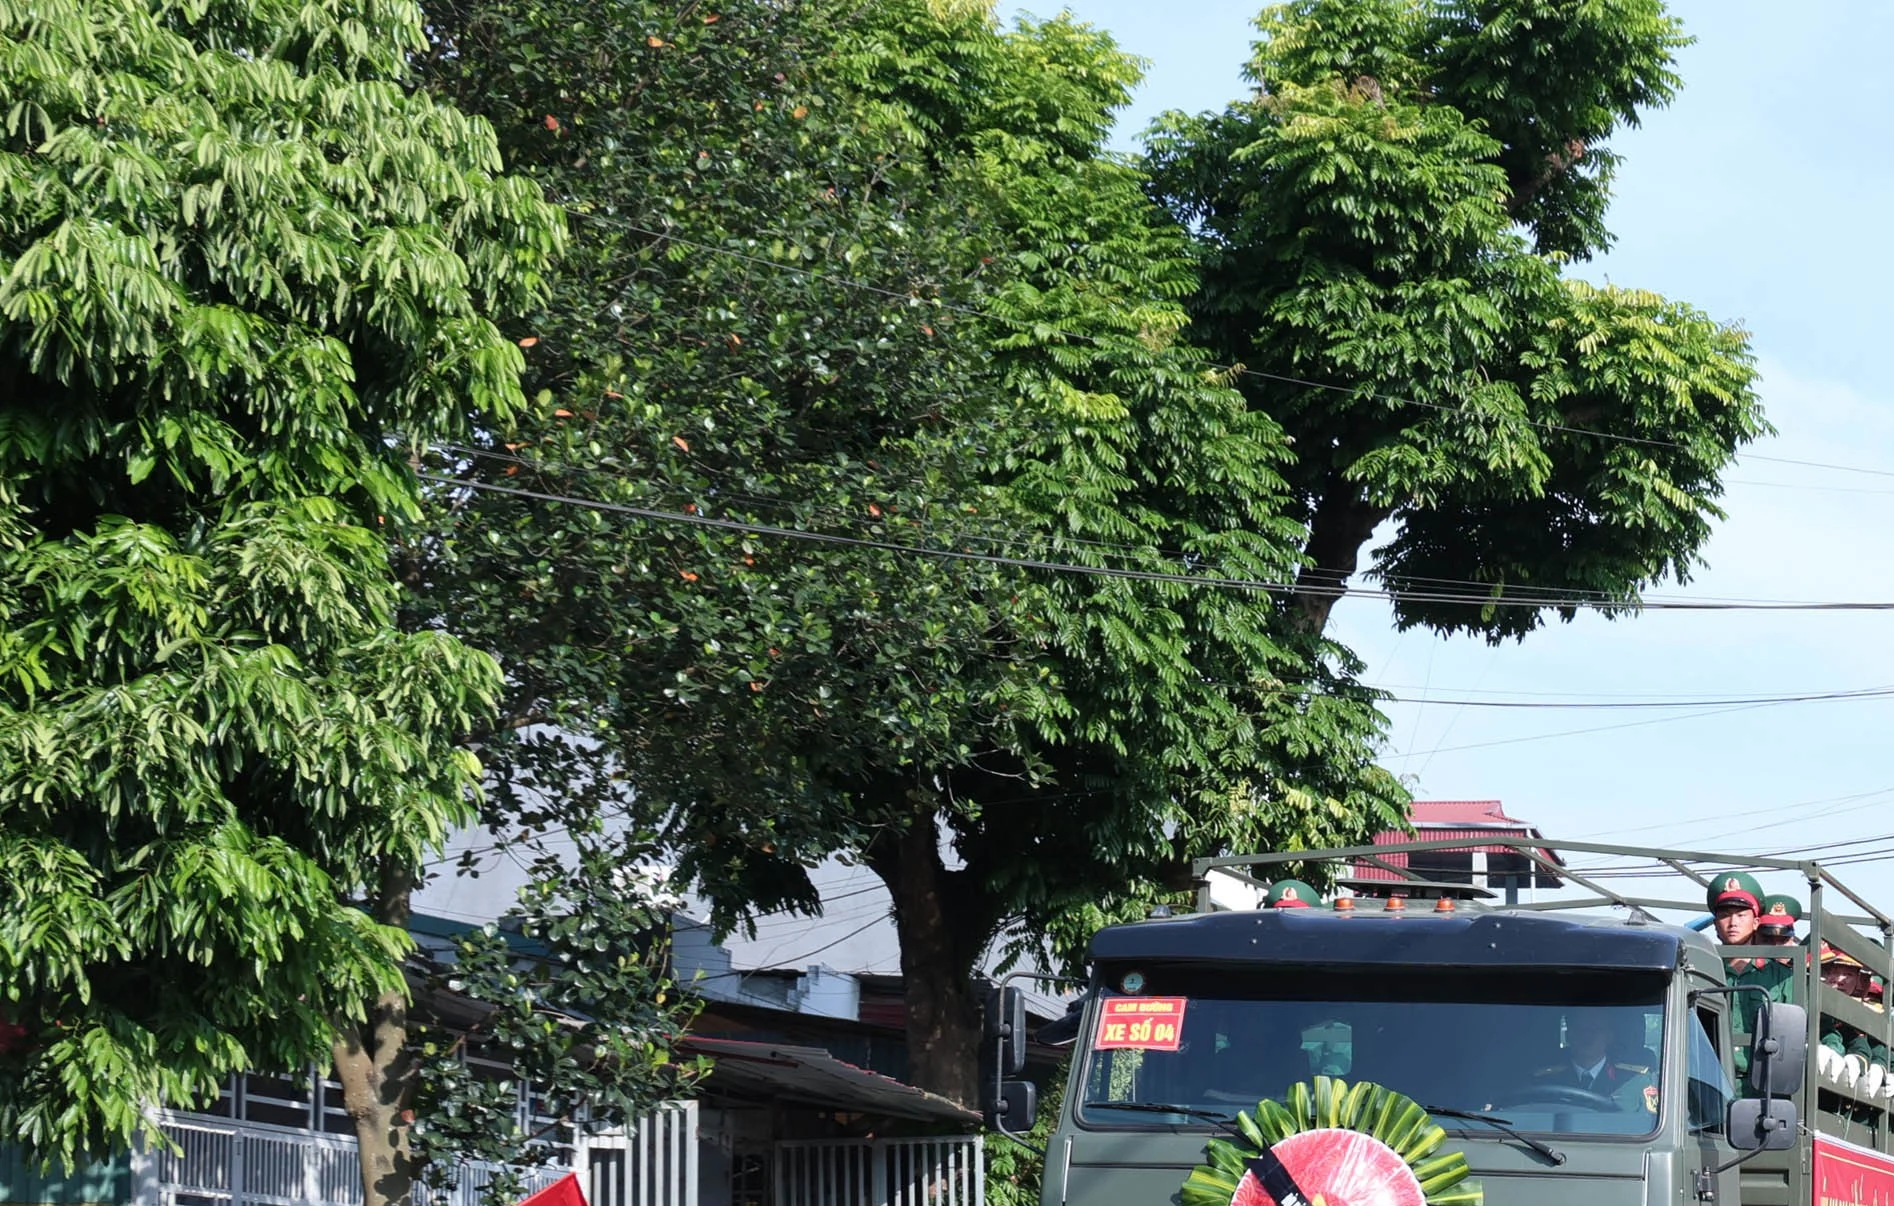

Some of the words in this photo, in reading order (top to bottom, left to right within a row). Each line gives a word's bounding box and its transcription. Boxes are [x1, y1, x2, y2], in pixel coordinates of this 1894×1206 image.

[1104, 1023, 1127, 1041] XE
[1128, 1017, 1154, 1042] SỐ
[1154, 1023, 1174, 1042] 04
